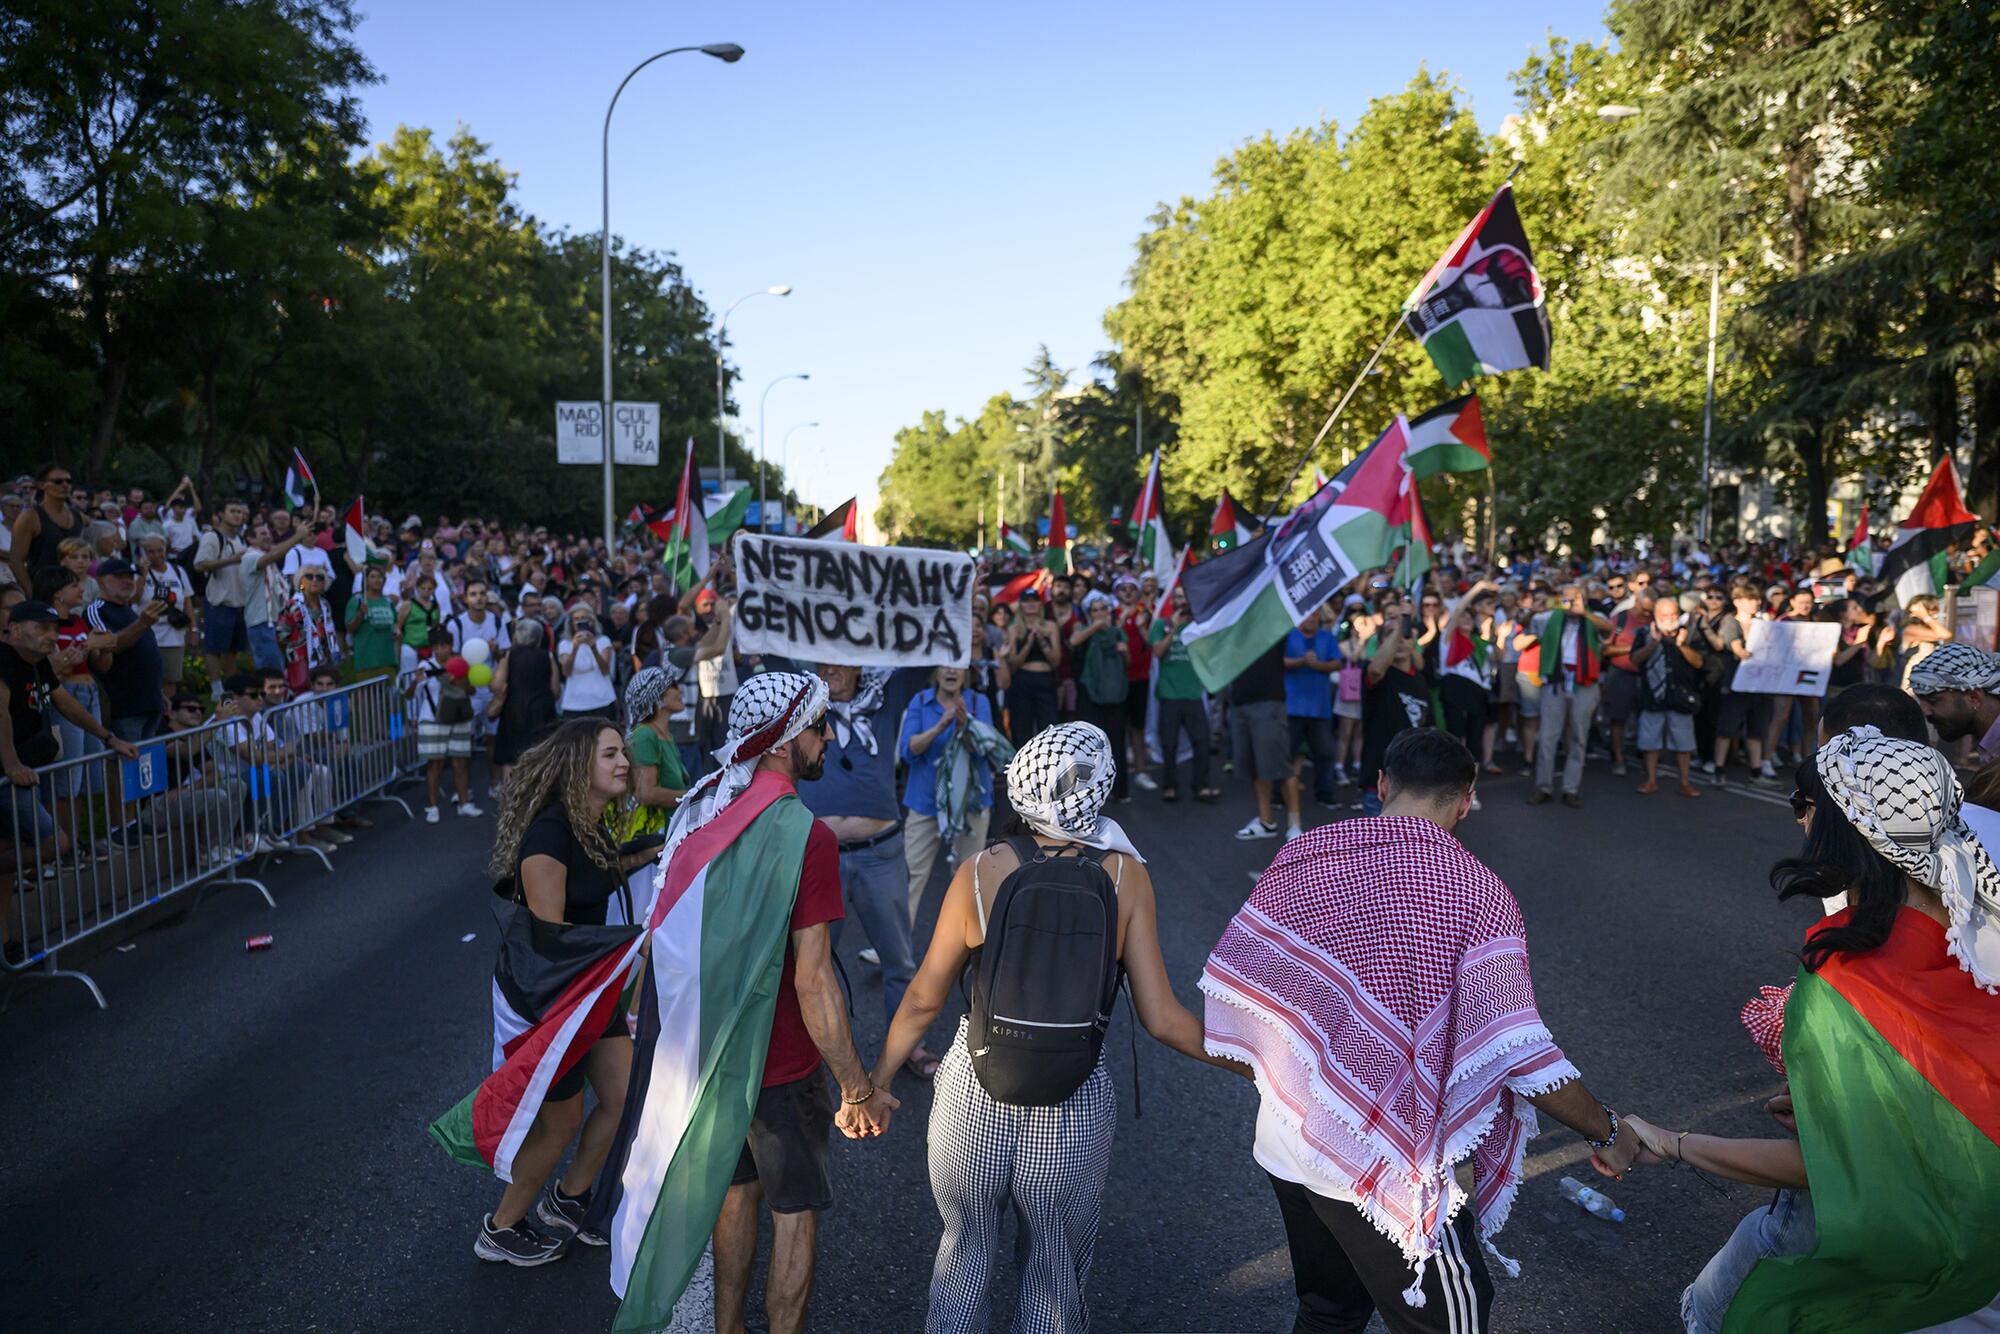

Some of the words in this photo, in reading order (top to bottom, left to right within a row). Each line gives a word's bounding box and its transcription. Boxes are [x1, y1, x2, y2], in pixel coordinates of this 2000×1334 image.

[559, 408, 601, 423] MAD
[616, 408, 651, 424] CUL
[575, 423, 601, 437] RID
[622, 424, 645, 439] TU
[634, 440, 656, 454] RA
[992, 1025, 1033, 1040] KIPSTA
